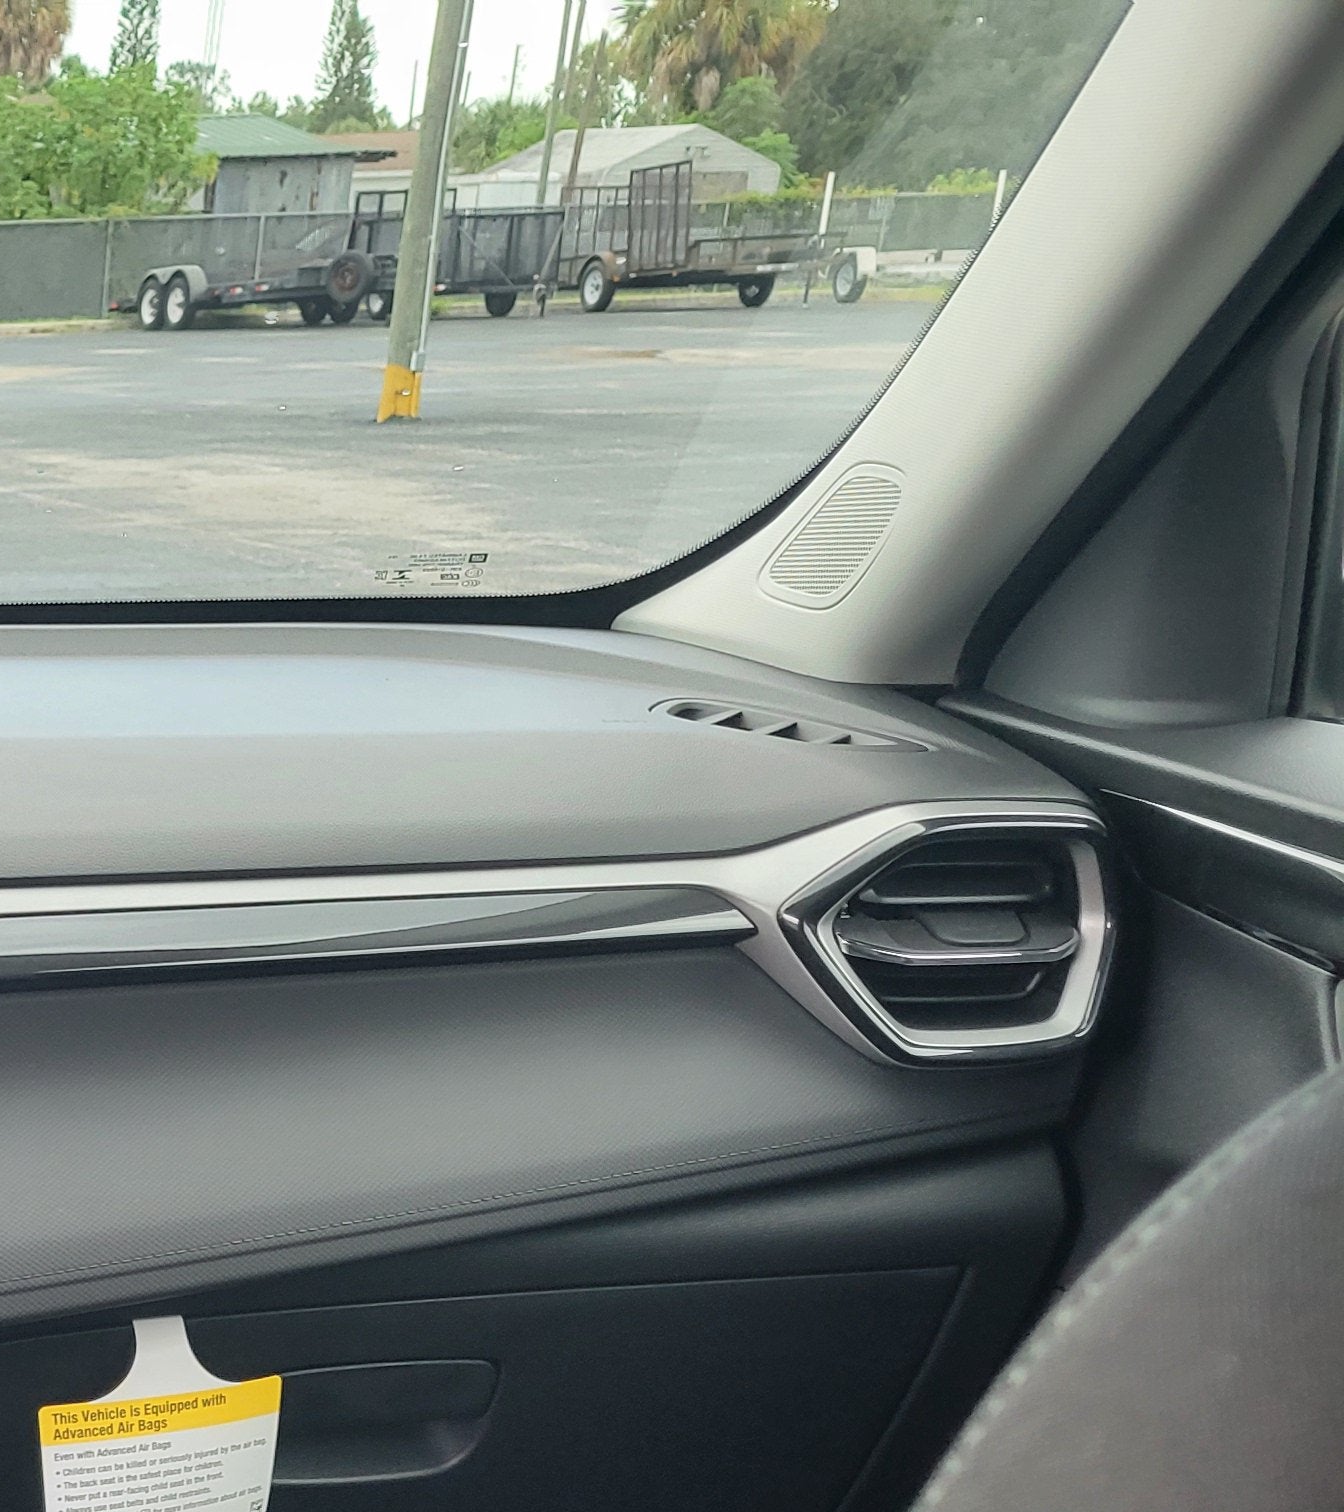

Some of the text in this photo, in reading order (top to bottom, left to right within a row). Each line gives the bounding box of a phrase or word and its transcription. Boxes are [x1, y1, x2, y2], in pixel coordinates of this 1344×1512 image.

[52, 1393, 227, 1425] This Vehicle is Equipped with
[53, 1418, 168, 1441] Advanced Air Bags
[54, 1441, 172, 1462] Even with Advanced Air Bags
